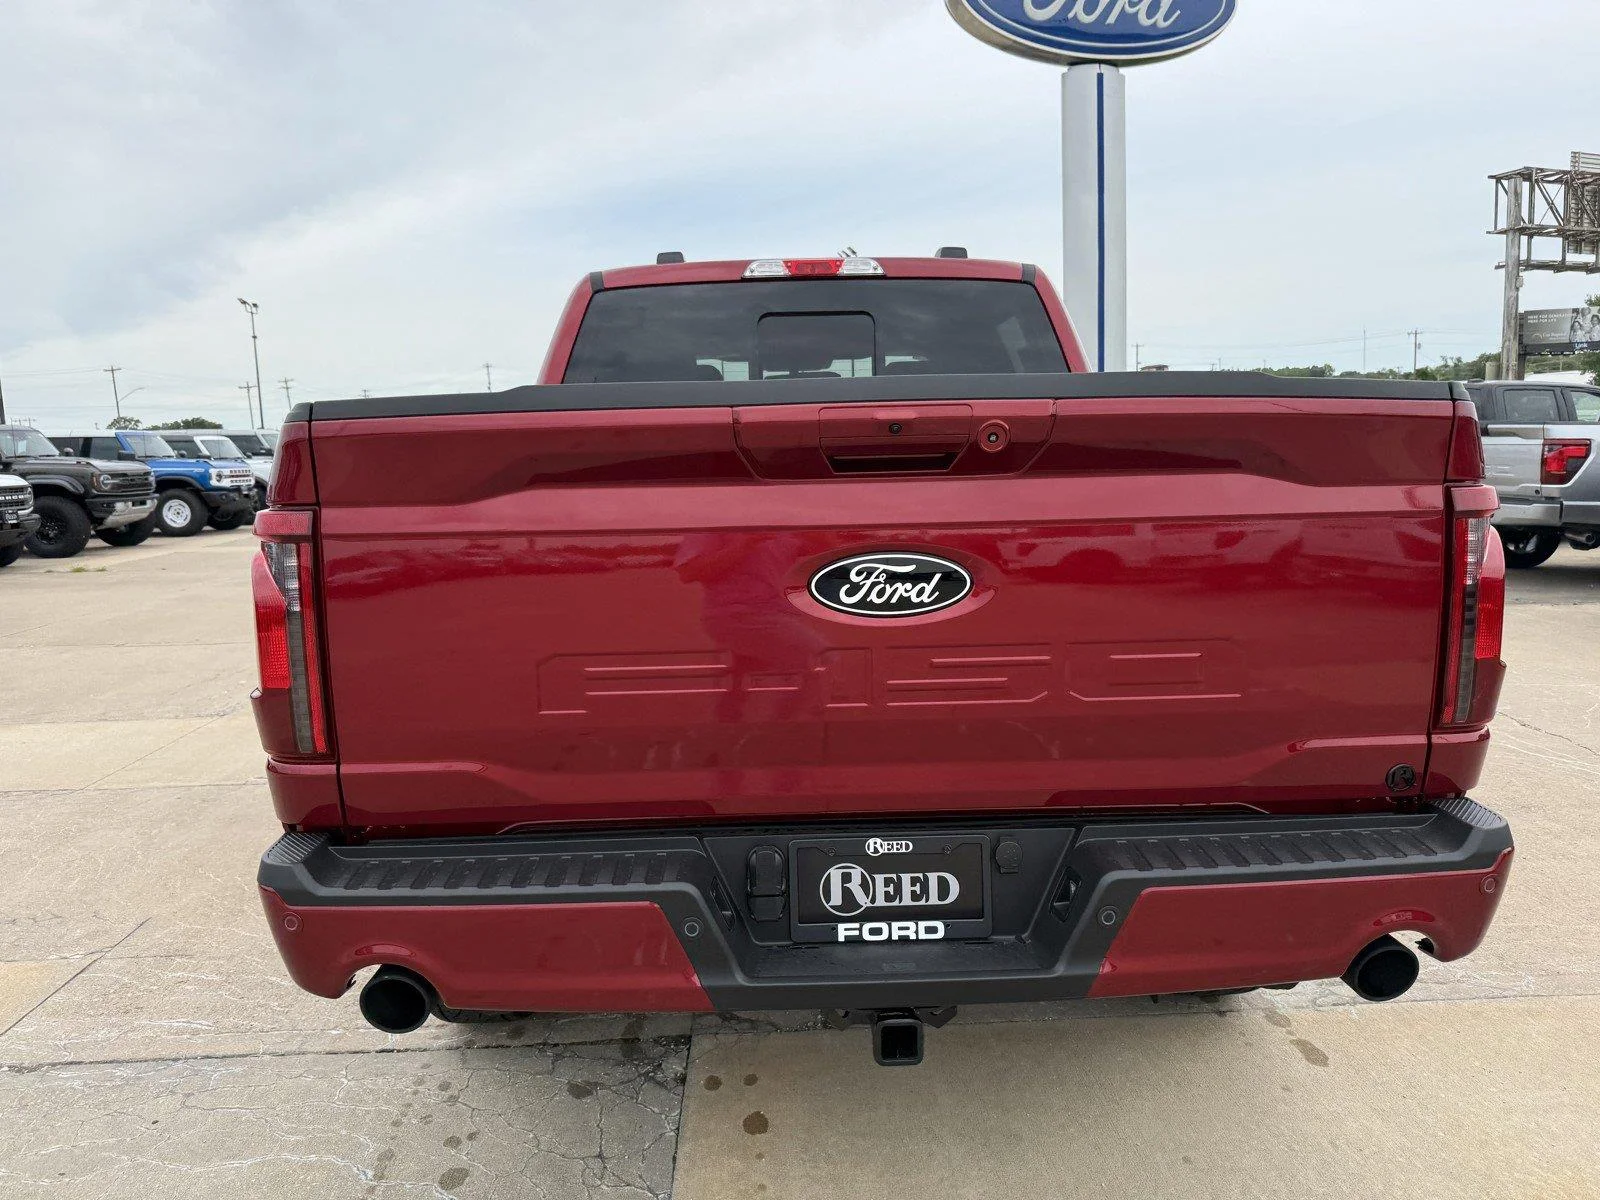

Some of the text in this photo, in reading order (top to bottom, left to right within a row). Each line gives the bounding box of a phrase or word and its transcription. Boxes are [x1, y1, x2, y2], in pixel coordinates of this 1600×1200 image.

[839, 563, 942, 604] Ford
[866, 838, 913, 856] REED
[826, 866, 960, 908] REED
[837, 921, 945, 942] FORD
